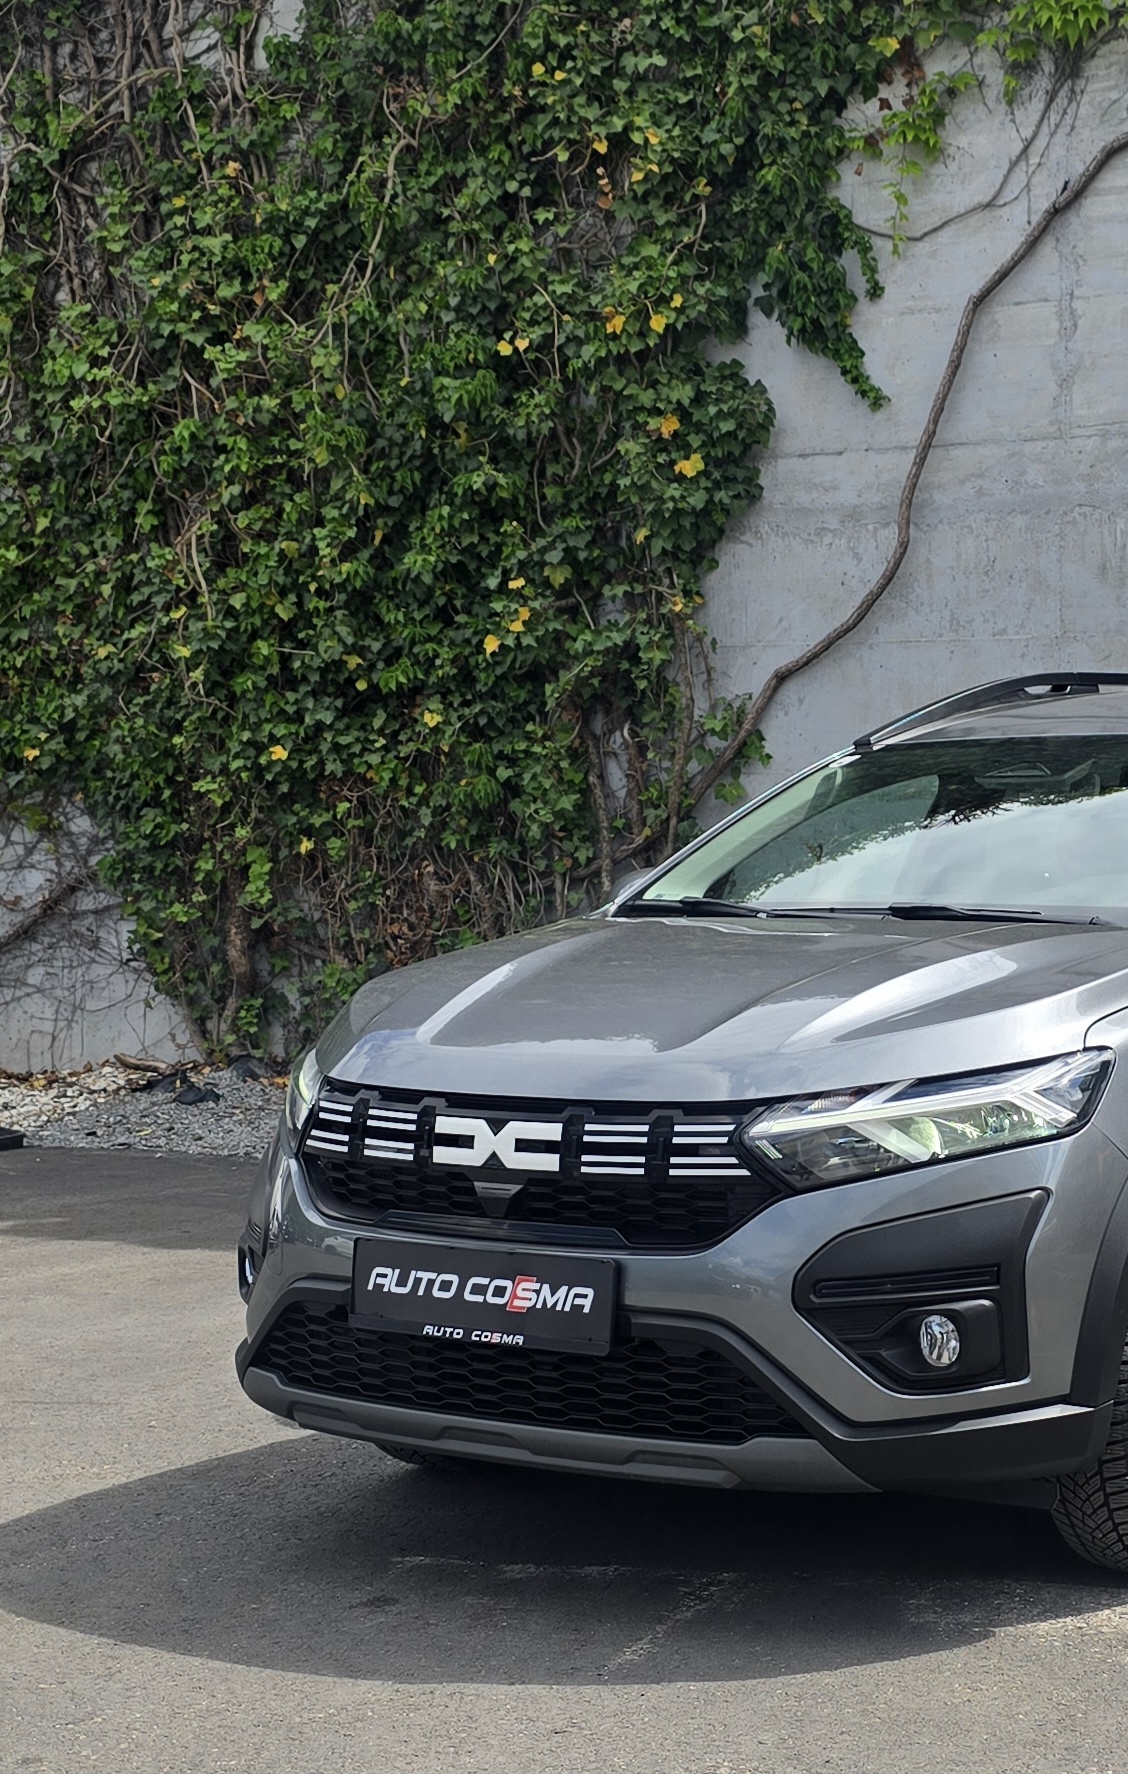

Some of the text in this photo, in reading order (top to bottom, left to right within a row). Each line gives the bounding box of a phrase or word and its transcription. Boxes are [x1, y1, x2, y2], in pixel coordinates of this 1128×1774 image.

[367, 1266, 594, 1313] AUTO COSMA
[422, 1324, 524, 1346] AUTO COSMA
